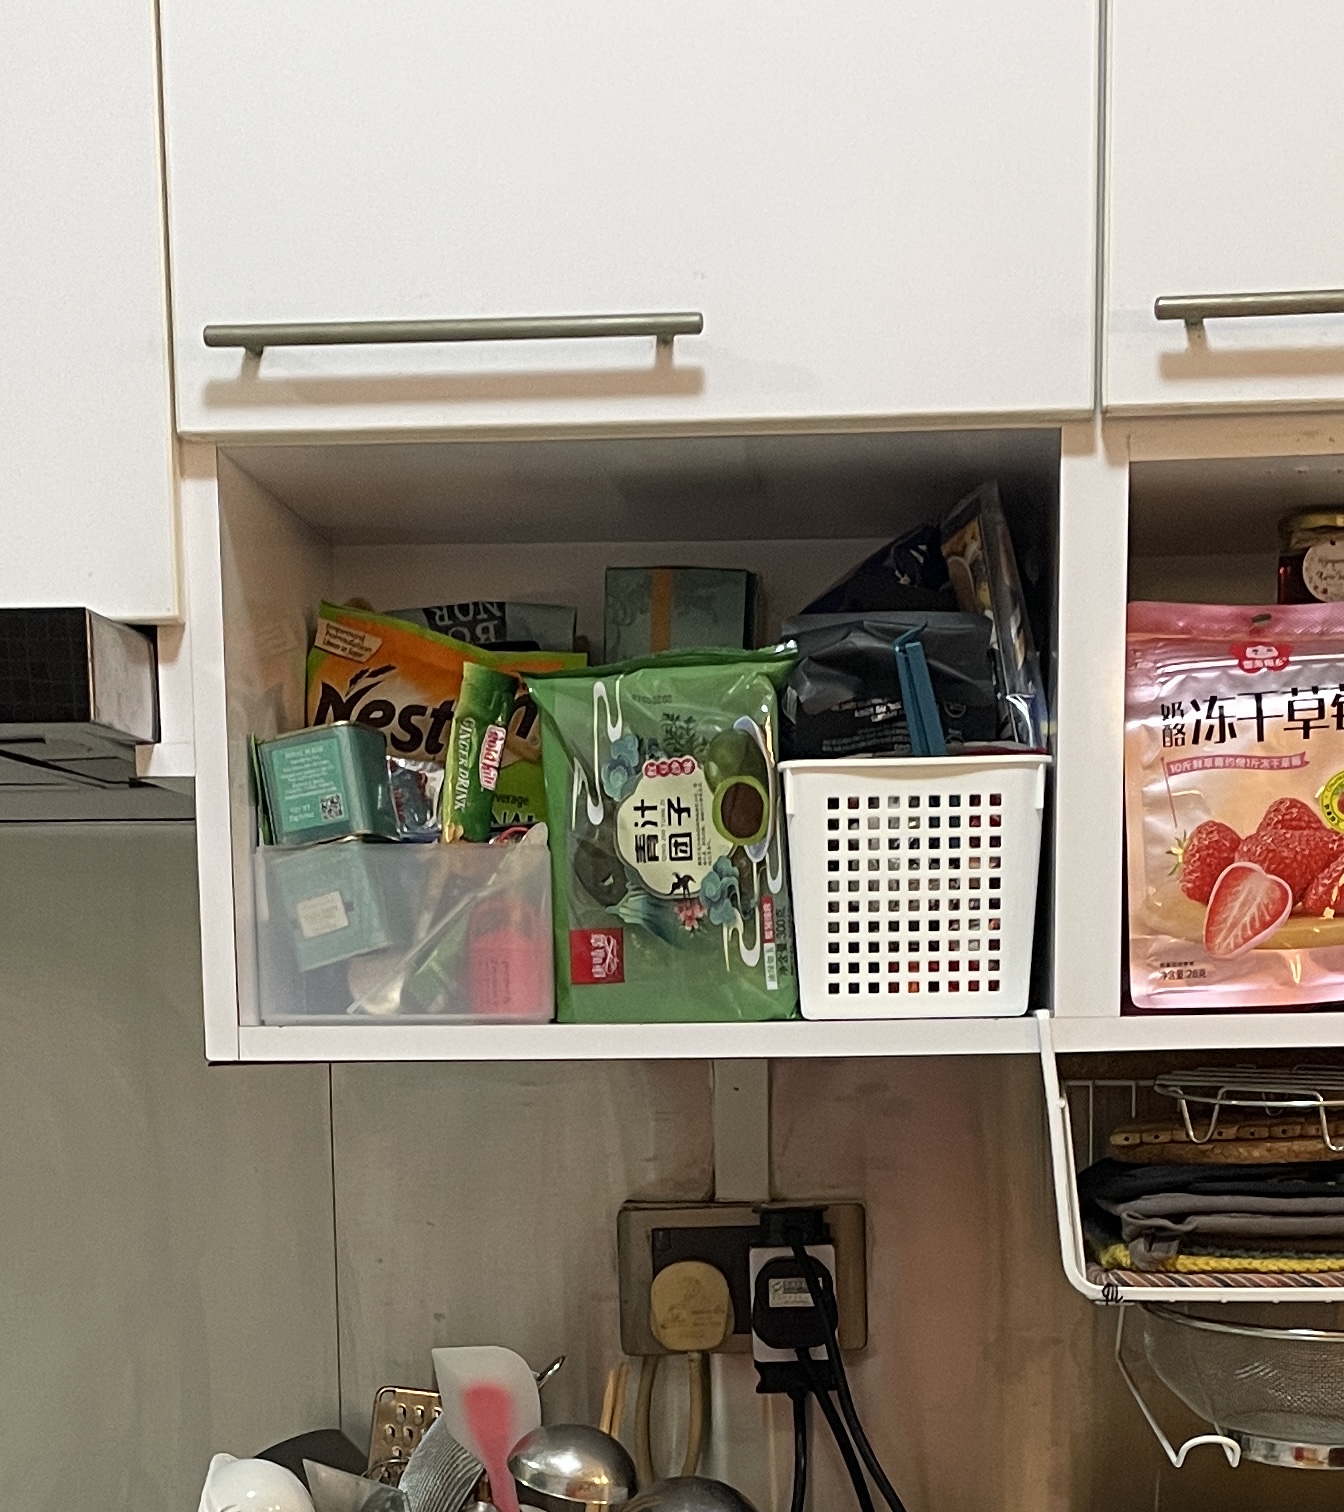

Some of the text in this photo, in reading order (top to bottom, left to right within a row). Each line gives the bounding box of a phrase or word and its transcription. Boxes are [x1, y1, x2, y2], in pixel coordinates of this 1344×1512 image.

[313, 676, 539, 755] Nest
[1160, 701, 1186, 747] 奶酪
[454, 716, 476, 812] GINGER DRINK
[633, 798, 659, 864] 青汁
[667, 796, 694, 862] 团子
